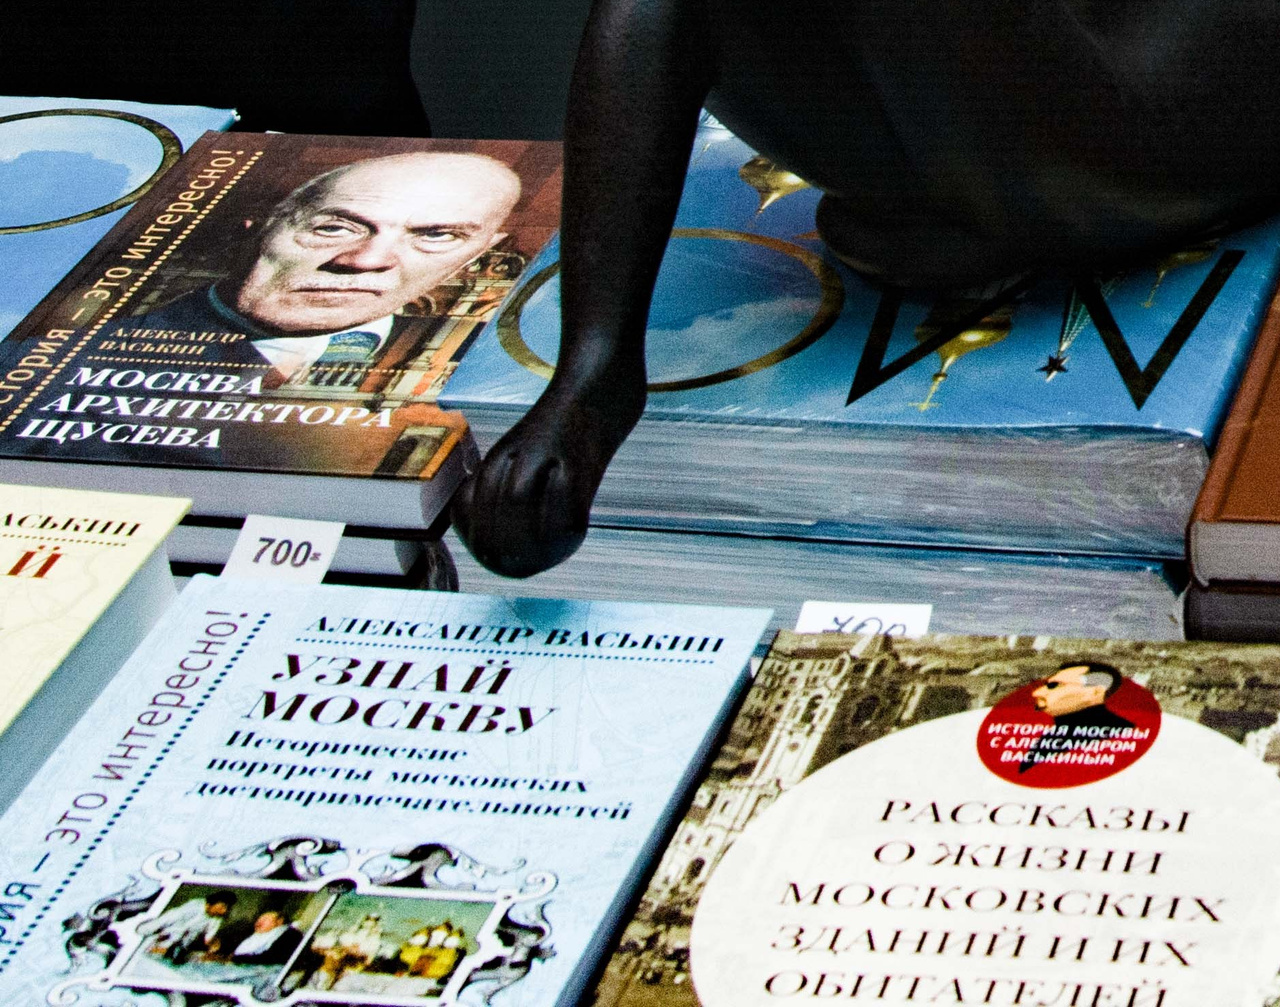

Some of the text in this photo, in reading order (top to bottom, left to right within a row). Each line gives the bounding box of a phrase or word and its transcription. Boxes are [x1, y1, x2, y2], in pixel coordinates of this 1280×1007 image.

[98, 340, 206, 356] ВАСЬКИН
[108, 326, 247, 344] АЛЕКСАНДР
[65, 366, 264, 395] МОСКВА
[40, 392, 394, 429] АРХИТЕКТОРА
[15, 417, 222, 449] ЩУСЕВА
[302, 615, 726, 654] АЛЕКСАНДР ВАСЬКИН
[271, 652, 518, 696] УЗНАЙ
[240, 690, 558, 737] МОСКВУ
[987, 722, 1151, 740] ИСТОРИЯ МОСКВЫ
[224, 729, 470, 764] Исторические
[989, 736, 1137, 754] С АЛЕКСАНДРОМ
[1000, 749, 1116, 766] ВАСЬКИНЫМ
[205, 758, 595, 795] портреты московских
[186, 781, 635, 822] достопримечательностей
[877, 798, 1195, 834] РАССКАЗЫ
[873, 840, 1164, 876] О ЖИЗНИ
[776, 880, 1227, 924] МОСКОВСКИХ
[770, 924, 1200, 968] ЗДАНИЙ И ИХ
[763, 969, 1170, 1007] ОБИТАТЕЛЕЙ
